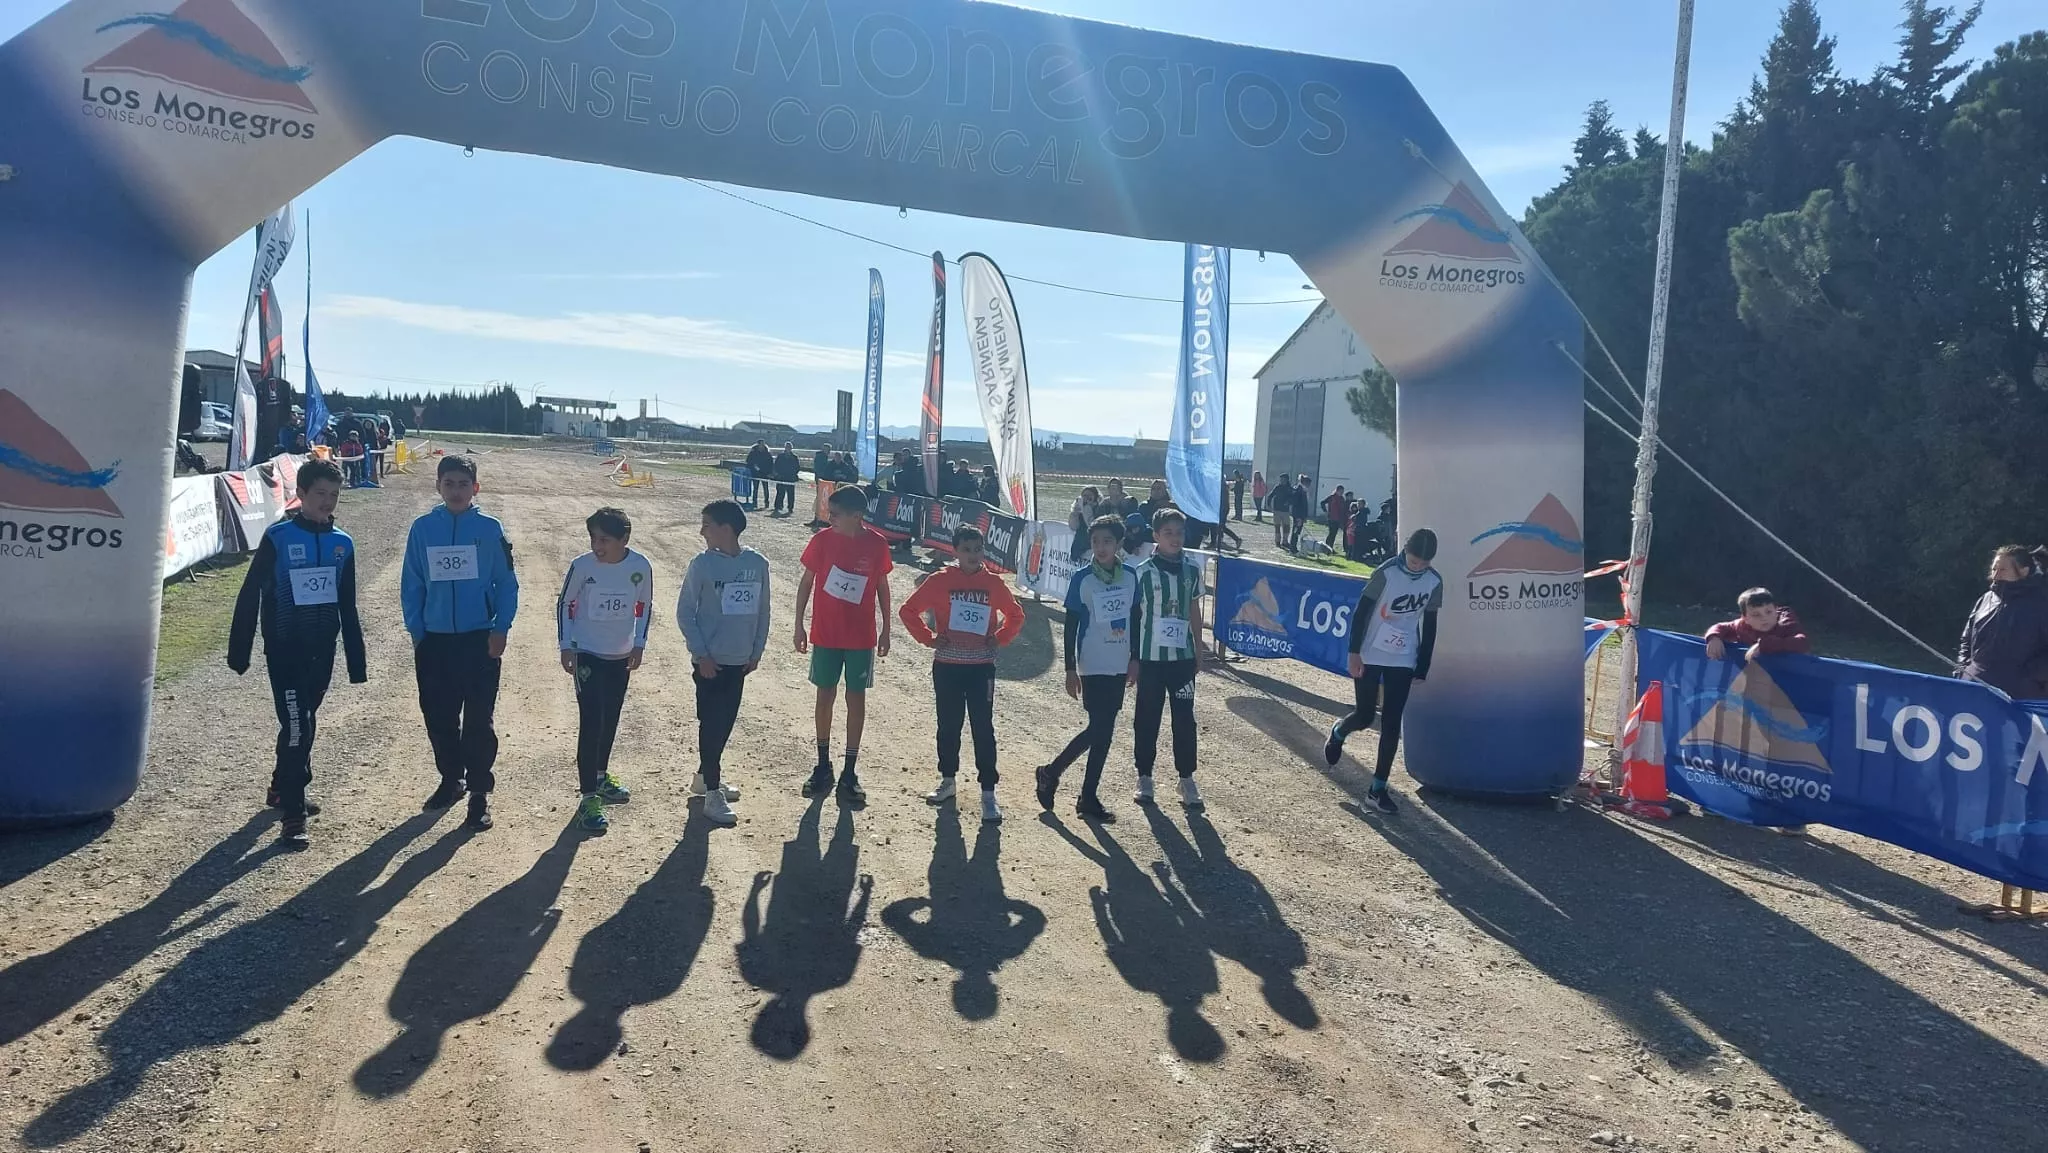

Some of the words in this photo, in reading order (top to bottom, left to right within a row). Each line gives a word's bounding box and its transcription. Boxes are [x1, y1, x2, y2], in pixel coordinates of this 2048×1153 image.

[734, 0, 1347, 159] Monegros
[82, 78, 140, 109] Los
[154, 90, 316, 139] Monegros
[421, 40, 740, 135] CONSEJO
[767, 97, 1085, 186] COMARCAL
[82, 103, 157, 127] CONSEJO
[163, 119, 248, 144] COMARCAL
[1381, 260, 1419, 280] Los
[1426, 263, 1526, 288] Monegros
[1379, 277, 1427, 292] CONSEJO
[1430, 283, 1485, 294] COMARCAL
[443, 556, 461, 570] 38
[308, 576, 327, 592] 37
[840, 582, 849, 592] 4
[1469, 581, 1509, 600] Los
[1518, 580, 1584, 600] Monegr
[735, 590, 751, 602] 23
[604, 599, 621, 611] 18
[1106, 599, 1121, 612] 32
[1469, 600, 1522, 611] CONSEJO
[963, 610, 979, 623] 35
[1166, 626, 1179, 638] 21
[1228, 627, 1245, 642] Los
[1681, 749, 1716, 775] Los
[1722, 758, 1832, 803] Monegros
